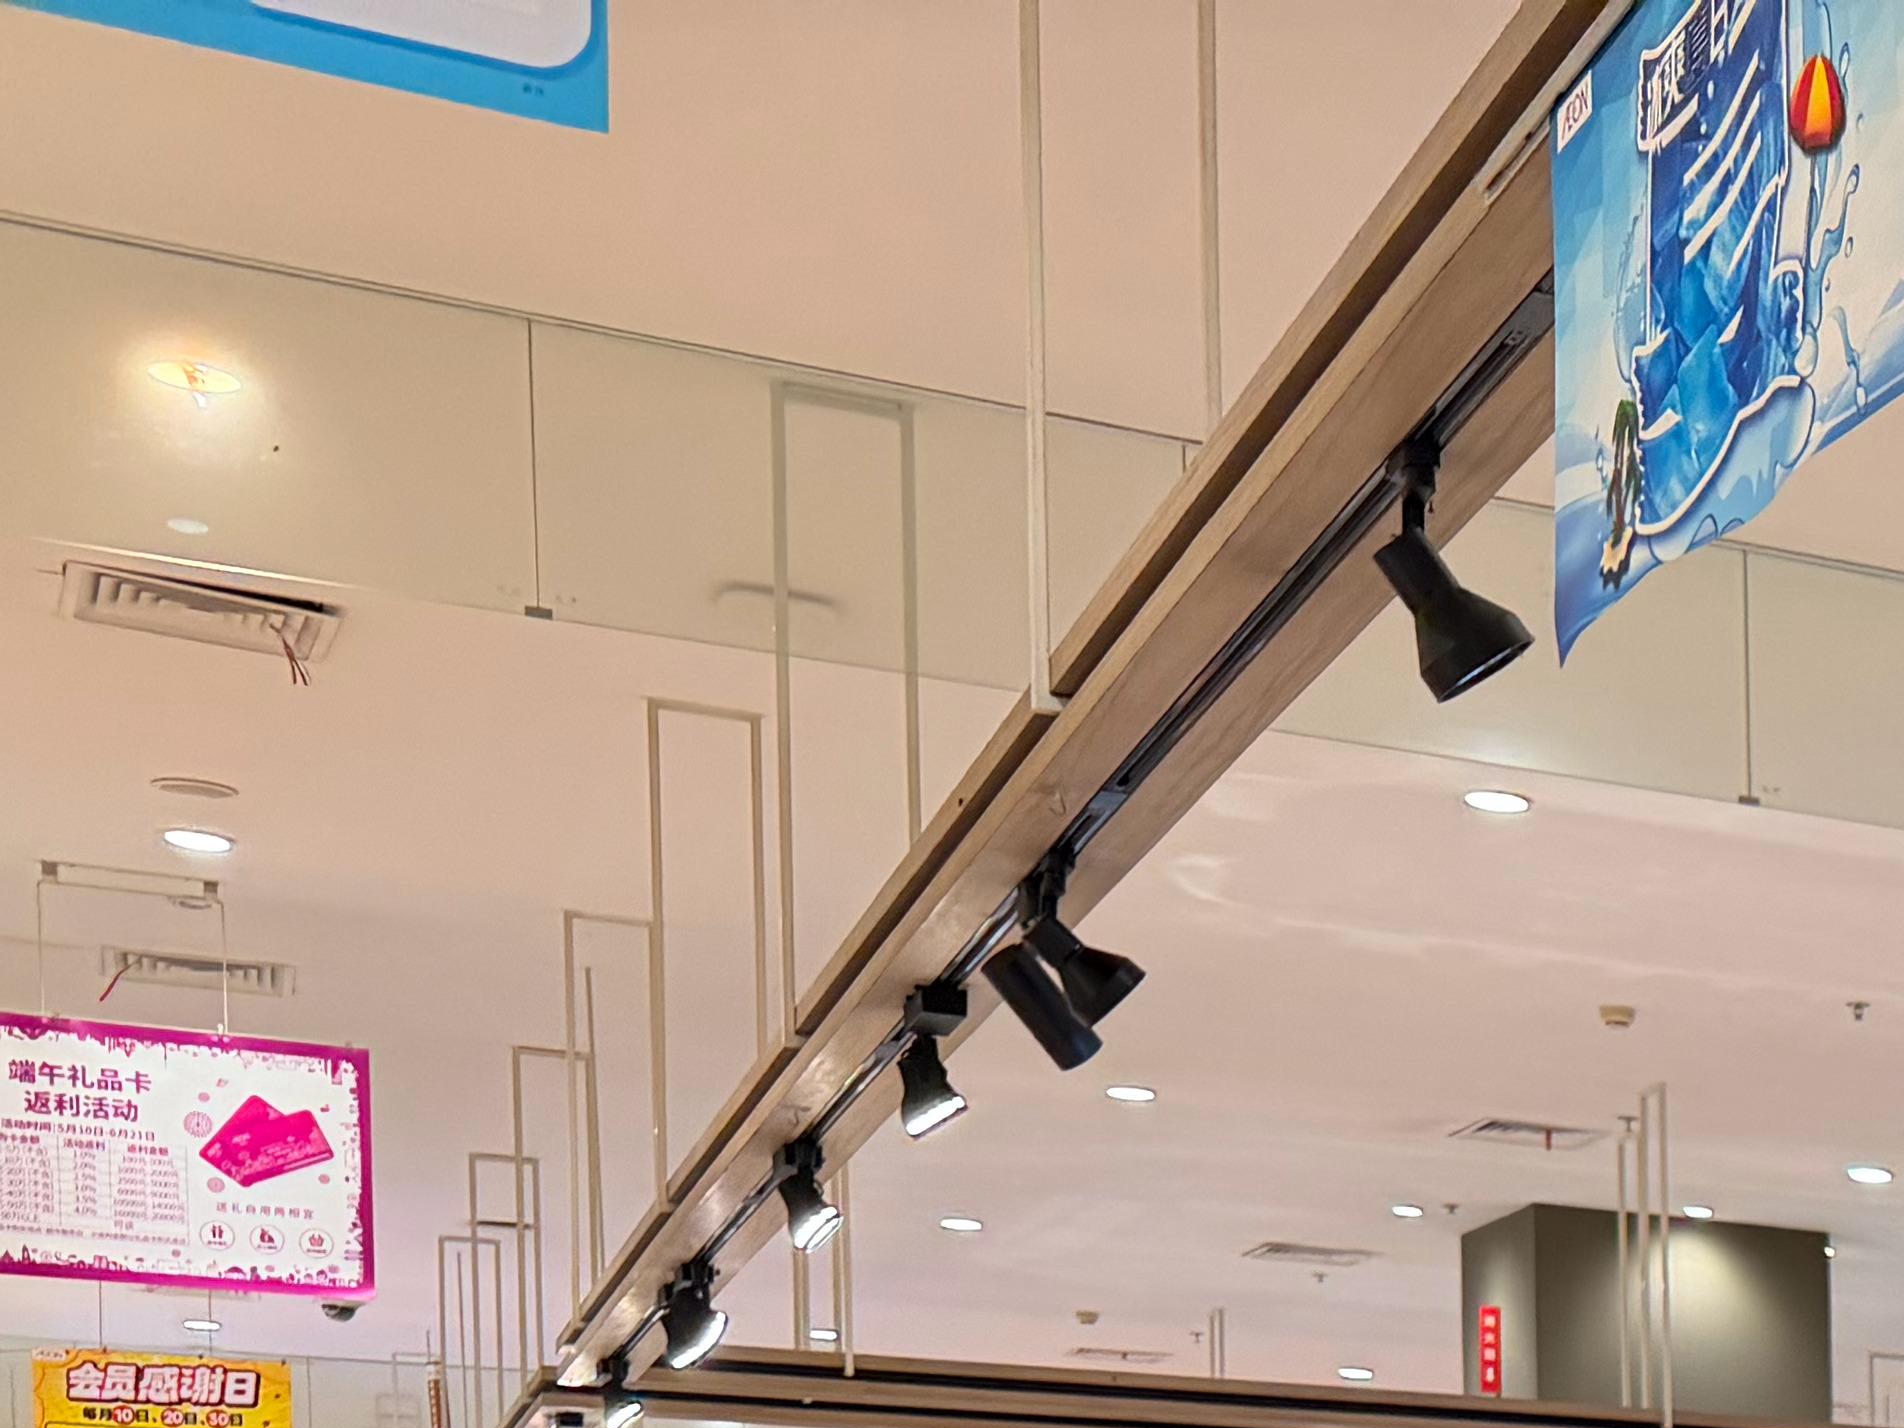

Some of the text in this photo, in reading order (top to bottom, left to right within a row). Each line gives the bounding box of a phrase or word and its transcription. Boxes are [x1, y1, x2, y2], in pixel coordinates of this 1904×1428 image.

[8, 1059, 152, 1094] 端午礼品卡
[24, 1090, 139, 1122] 返利活动
[67, 1361, 261, 1407] 会员感谢日
